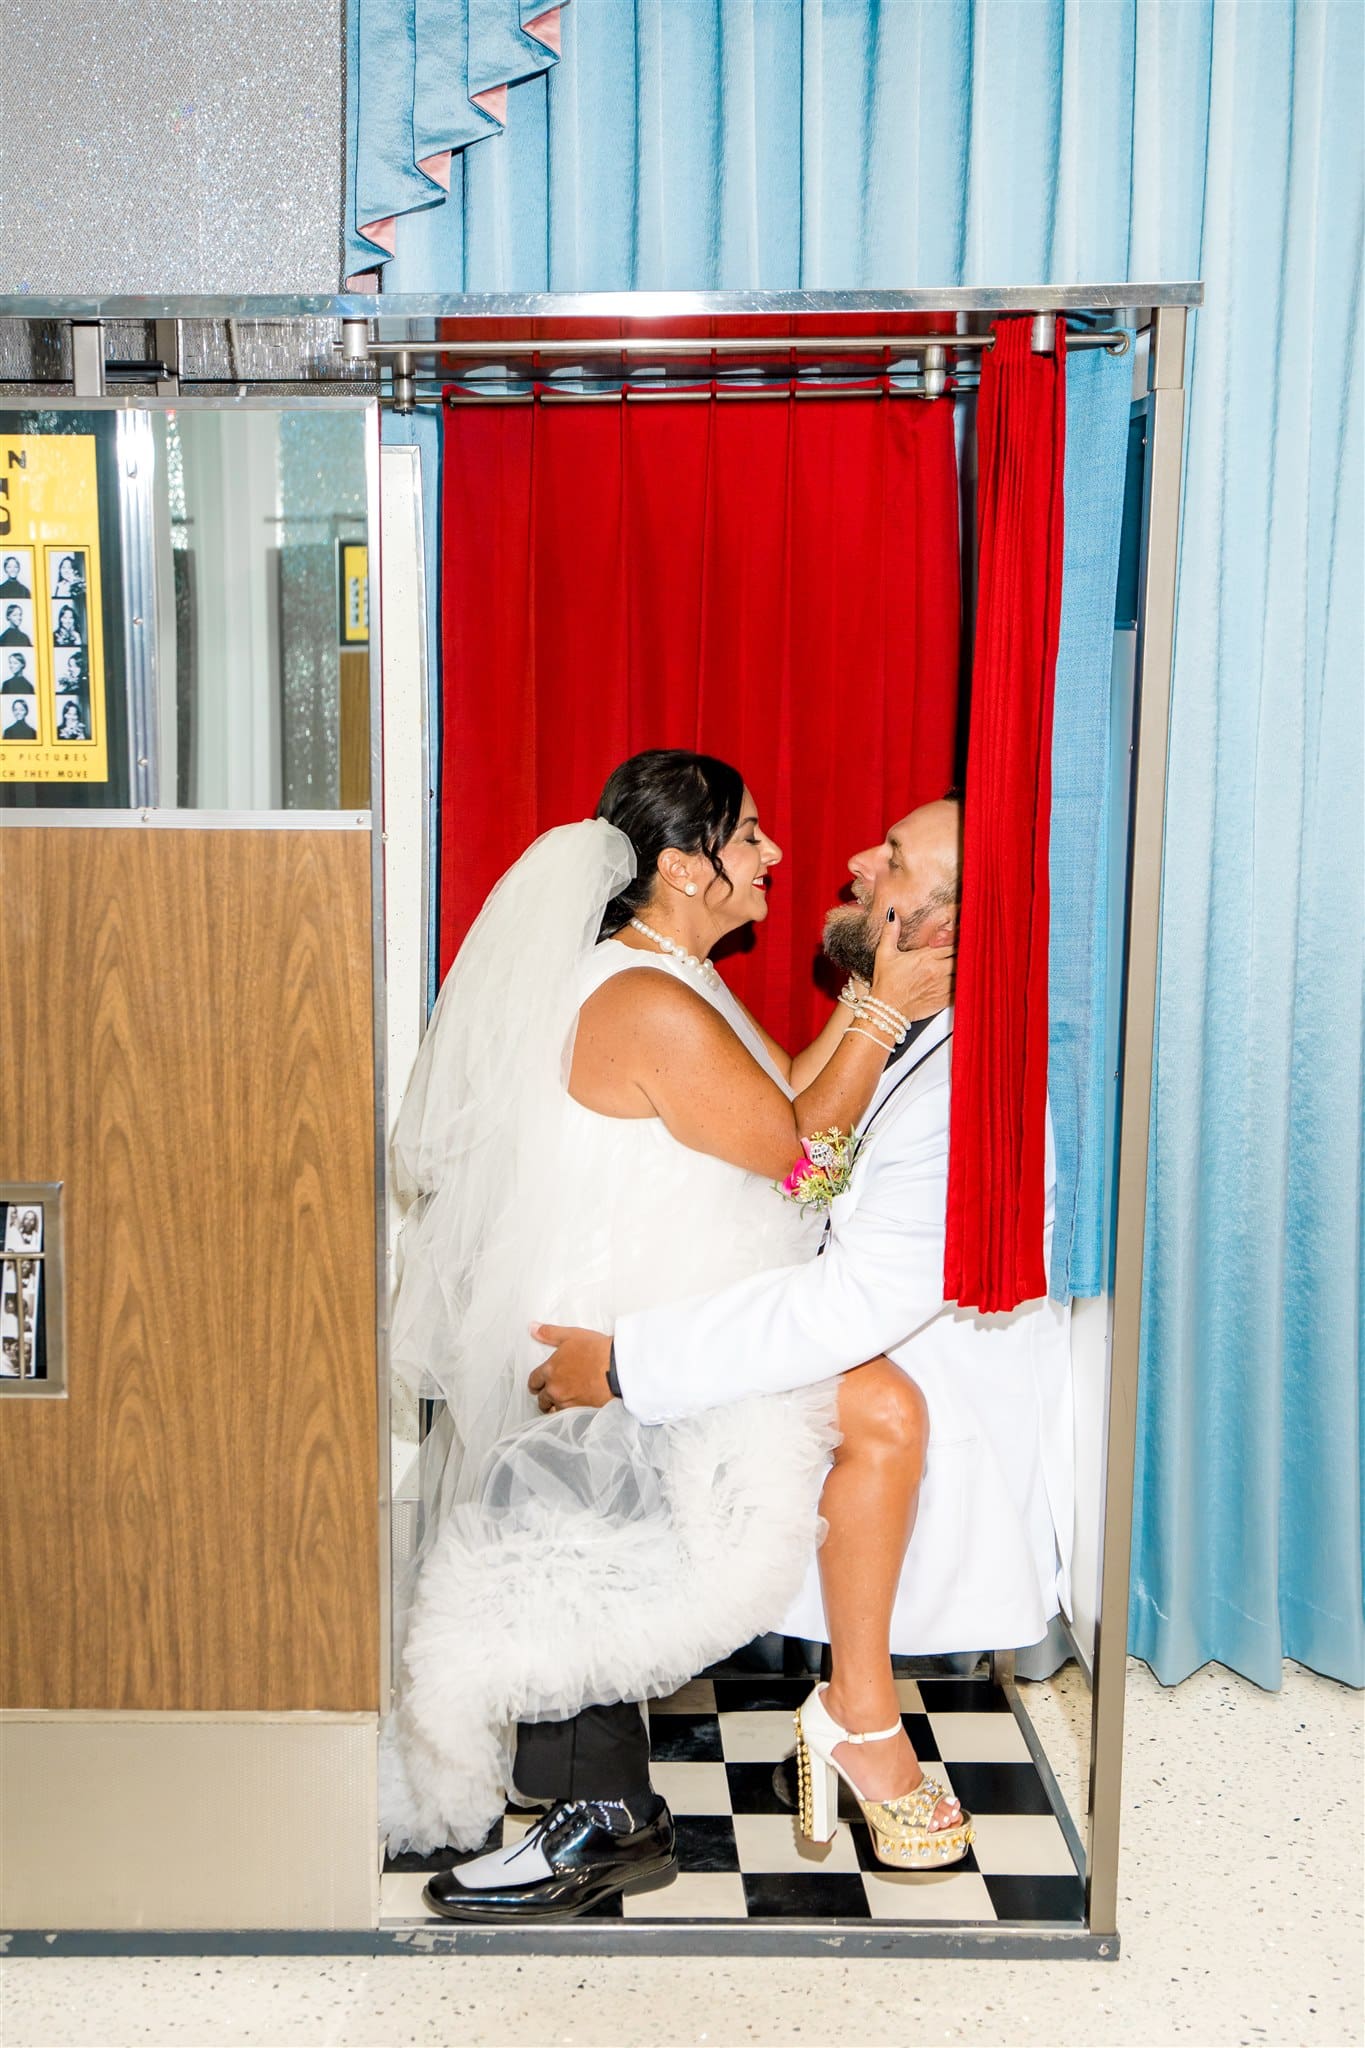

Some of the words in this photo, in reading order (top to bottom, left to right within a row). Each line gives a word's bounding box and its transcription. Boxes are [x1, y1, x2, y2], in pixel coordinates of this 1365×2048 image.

[19, 753, 87, 762] PICTURES
[24, 770, 49, 778] THEY
[58, 770, 88, 778] MOVE
